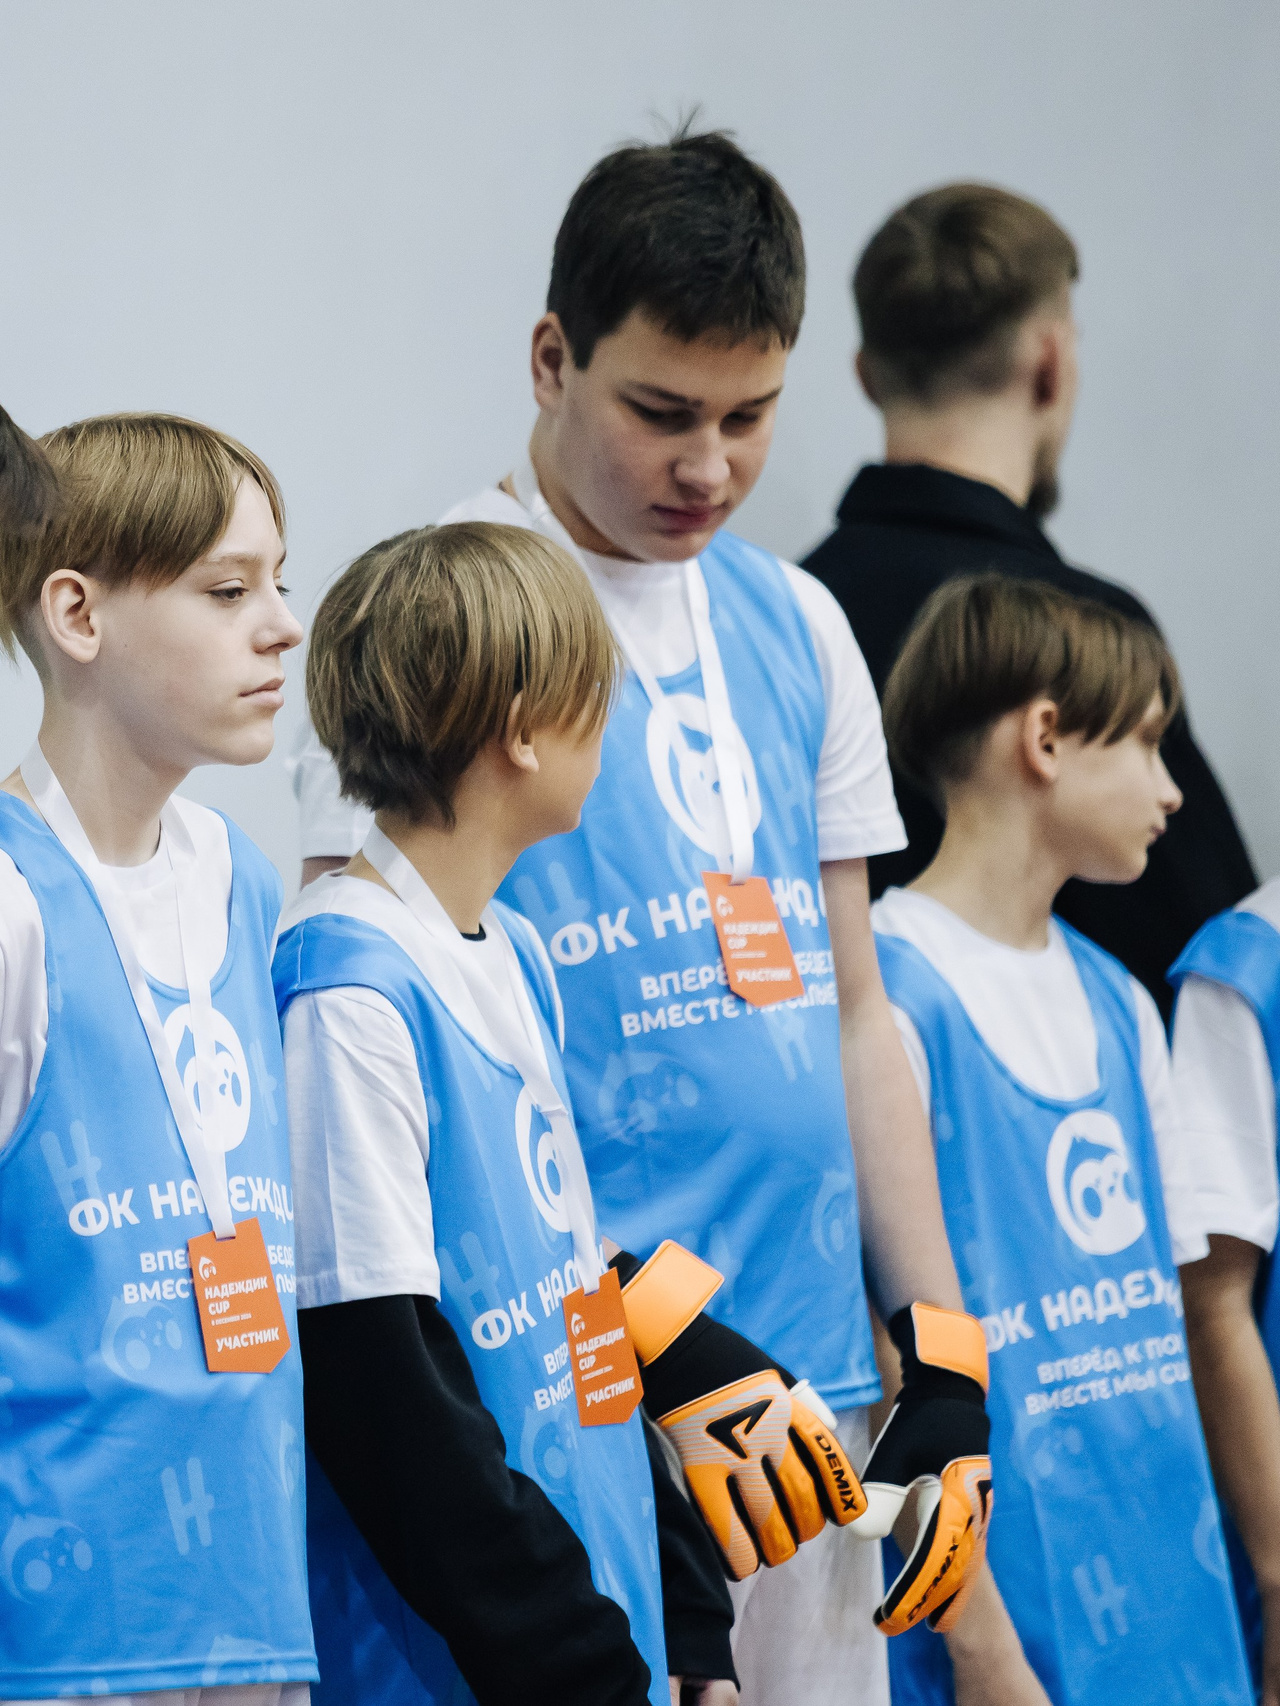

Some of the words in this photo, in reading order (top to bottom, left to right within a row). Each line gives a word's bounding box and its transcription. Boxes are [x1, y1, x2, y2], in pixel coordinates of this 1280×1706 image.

[550, 907, 639, 966] ФК
[621, 995, 741, 1037] ВМЕСТЕ
[68, 1187, 141, 1237] ФК
[204, 1276, 269, 1300] НАДЕЖДИК
[208, 1300, 231, 1315] CUP
[471, 1291, 537, 1350] ФК
[216, 1327, 280, 1352] УЧАСТНИК
[576, 1326, 625, 1355] НАДЕЖДИК
[578, 1355, 597, 1371] CUP
[585, 1377, 635, 1407] УЧАСТНИК
[814, 1433, 858, 1513] DEMIX
